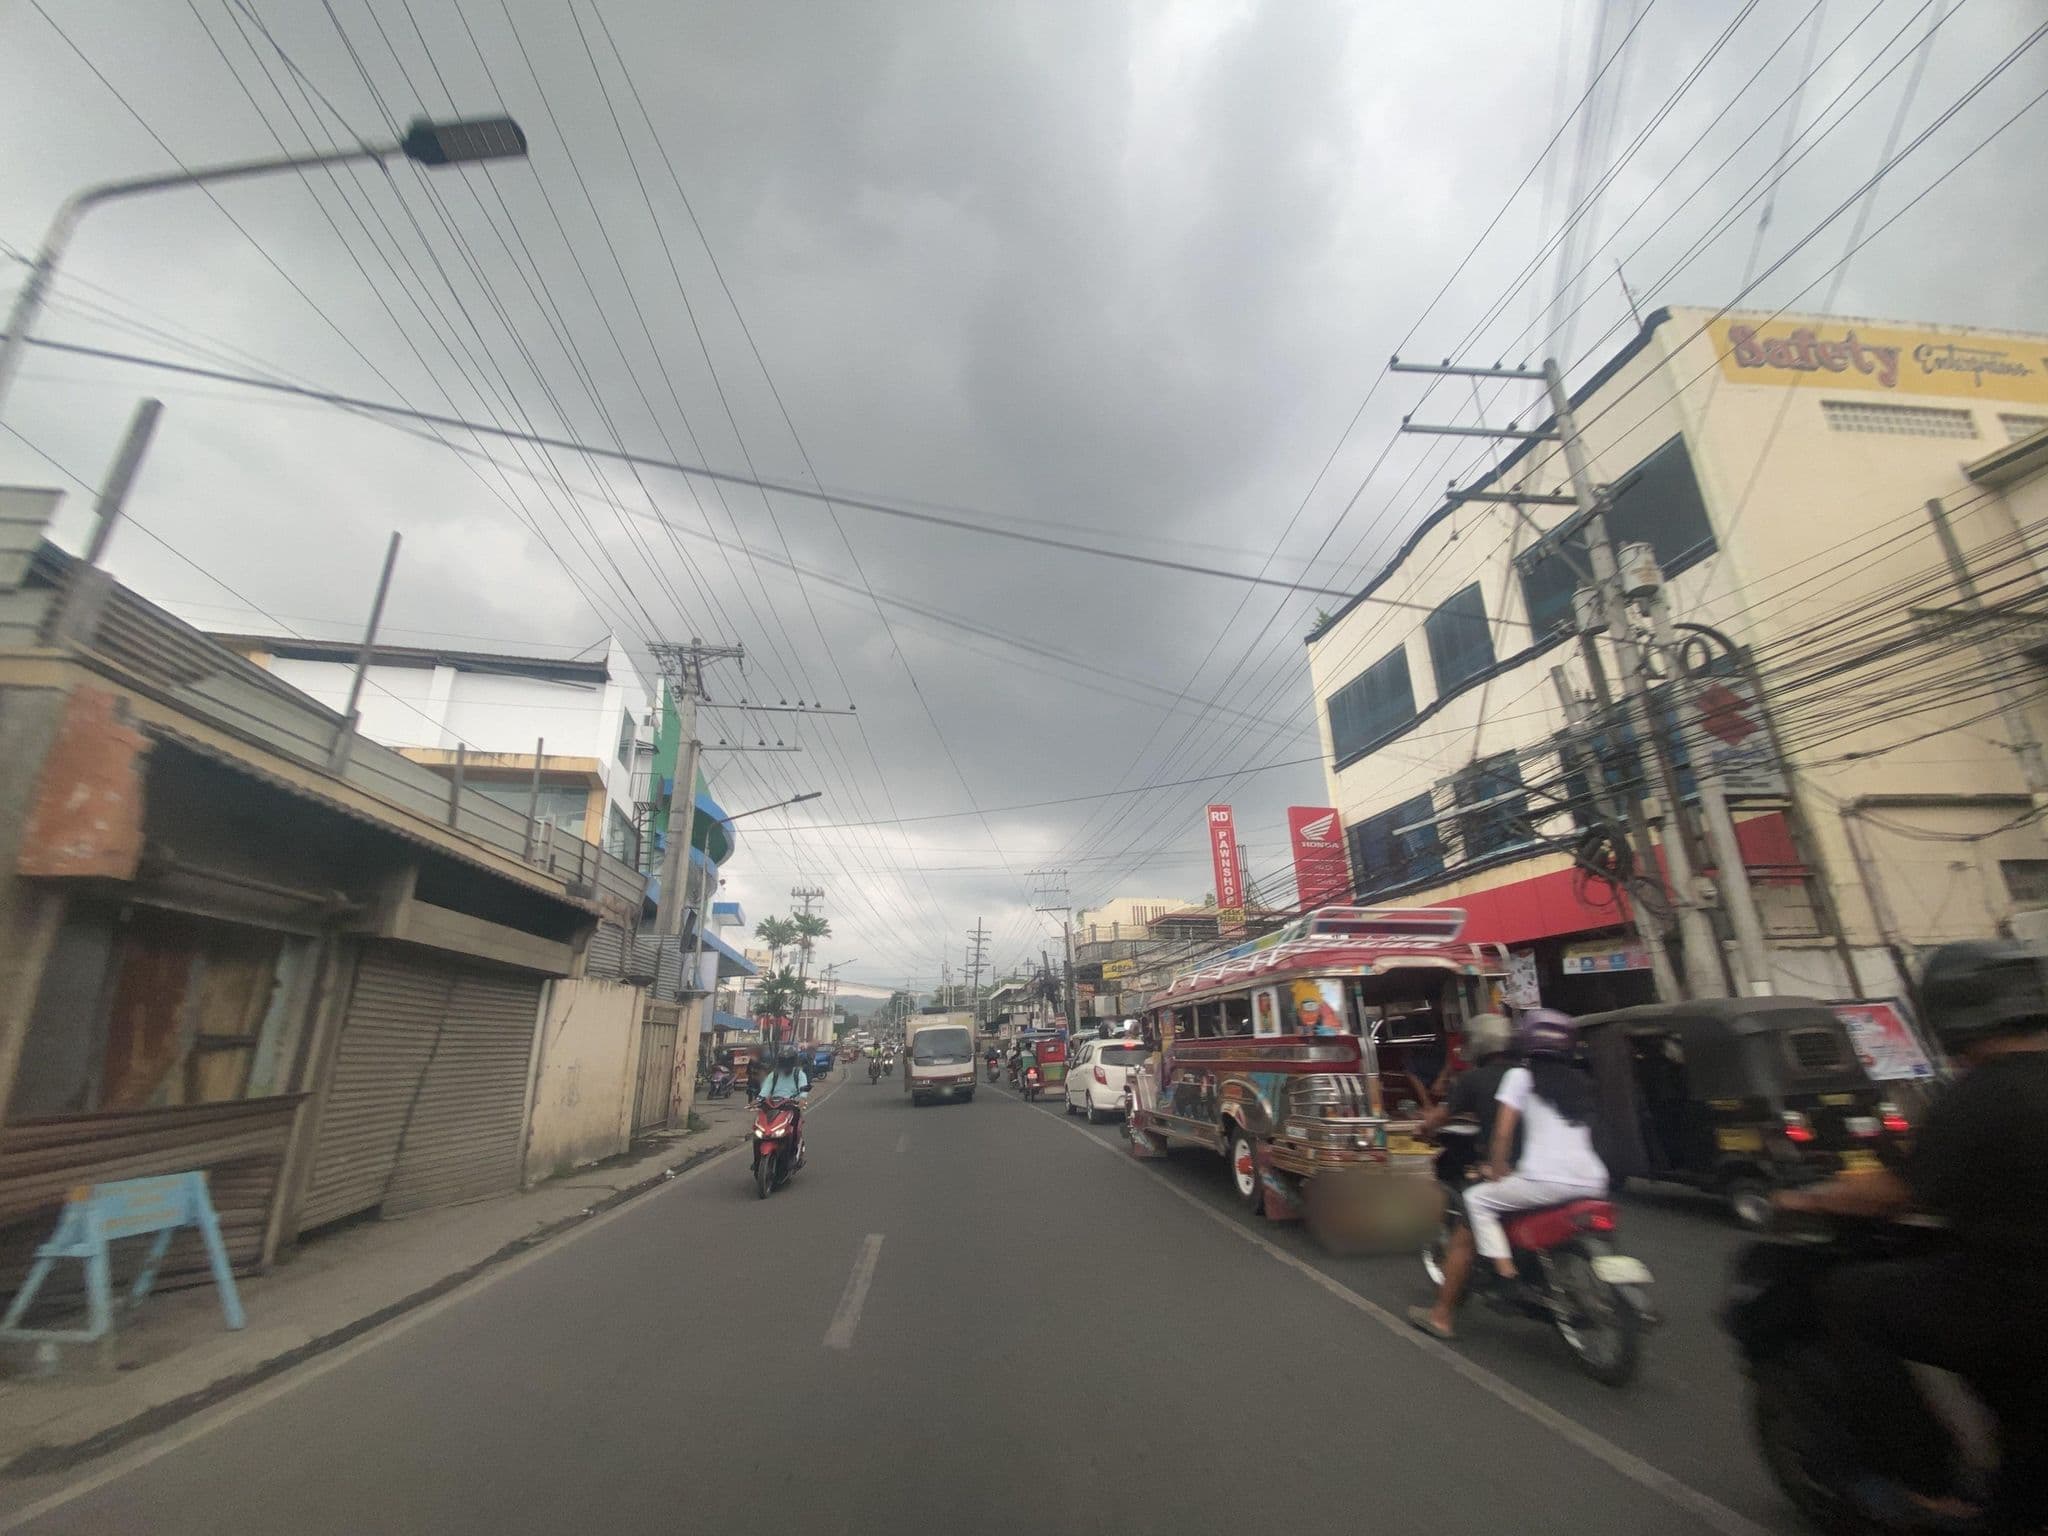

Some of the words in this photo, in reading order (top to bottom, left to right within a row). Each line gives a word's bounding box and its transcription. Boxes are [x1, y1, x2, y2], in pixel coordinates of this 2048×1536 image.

[1728, 325, 1902, 388] Safety
[1211, 811, 1229, 822] RD
[1301, 841, 1340, 849] HONDA
[1218, 831, 1235, 905] PAWNSHOP
